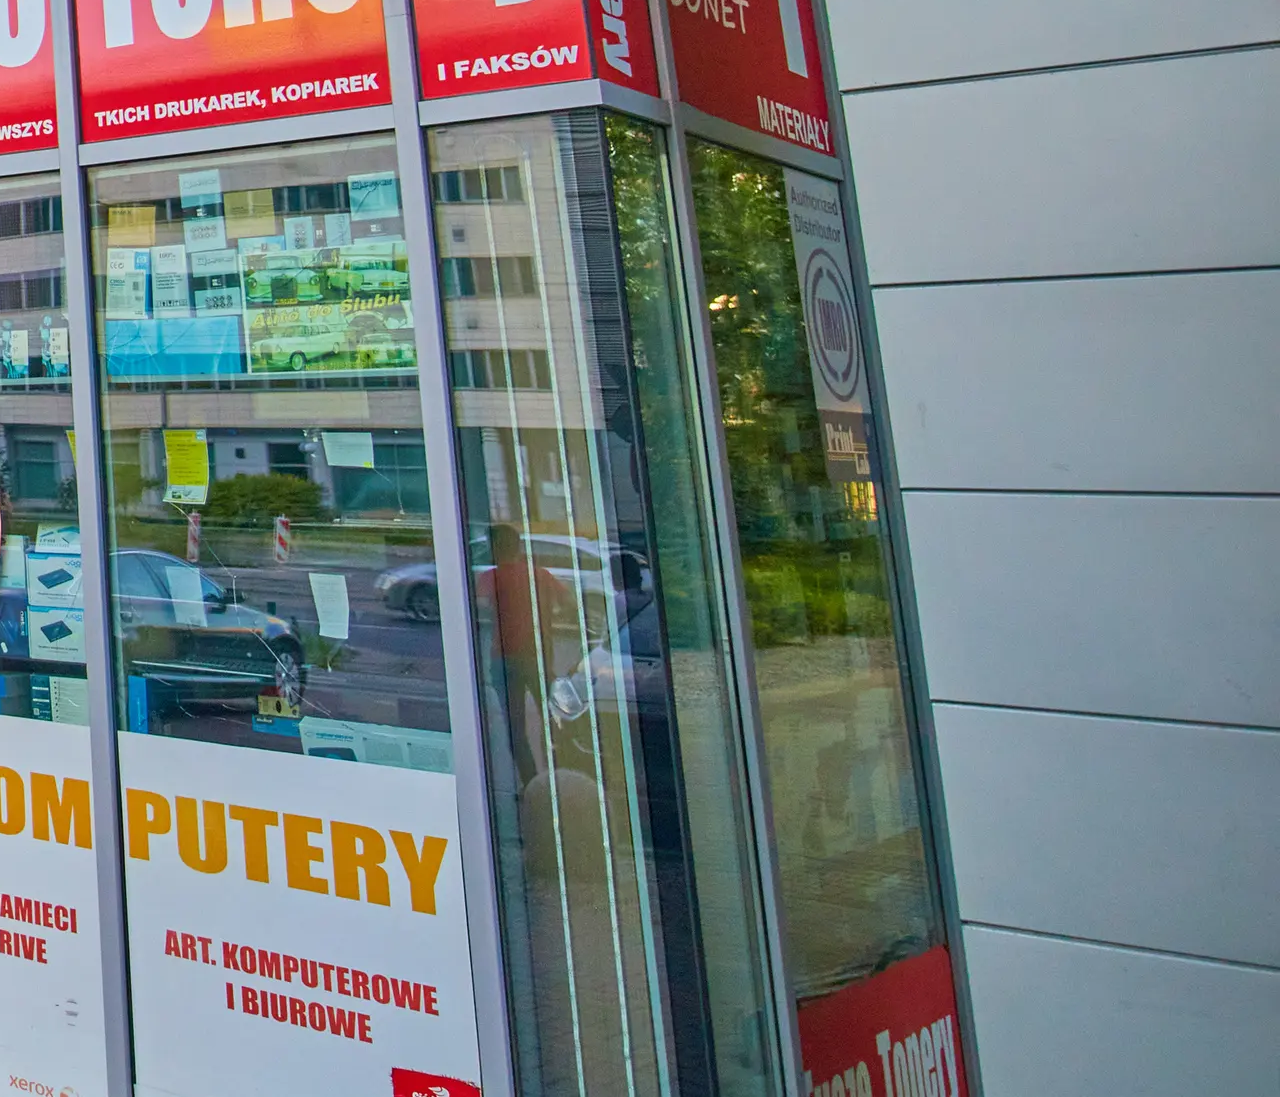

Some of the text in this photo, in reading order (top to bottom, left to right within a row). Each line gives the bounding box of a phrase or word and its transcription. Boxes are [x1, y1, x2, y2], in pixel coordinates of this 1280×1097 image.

[154, 90, 268, 118] DRUKAREK,
[272, 73, 379, 103] KOPIAREK
[454, 42, 578, 80] FAKSÓW
[756, 94, 831, 153] MATERIAŁY
[791, 186, 838, 215] Authorized
[794, 213, 840, 242] Distributor
[825, 422, 854, 452] Print
[165, 929, 439, 1016] ART. KOMPUTEROWE
[226, 982, 373, 1044] I BIUROWE
[9, 1074, 54, 1097] xerox
